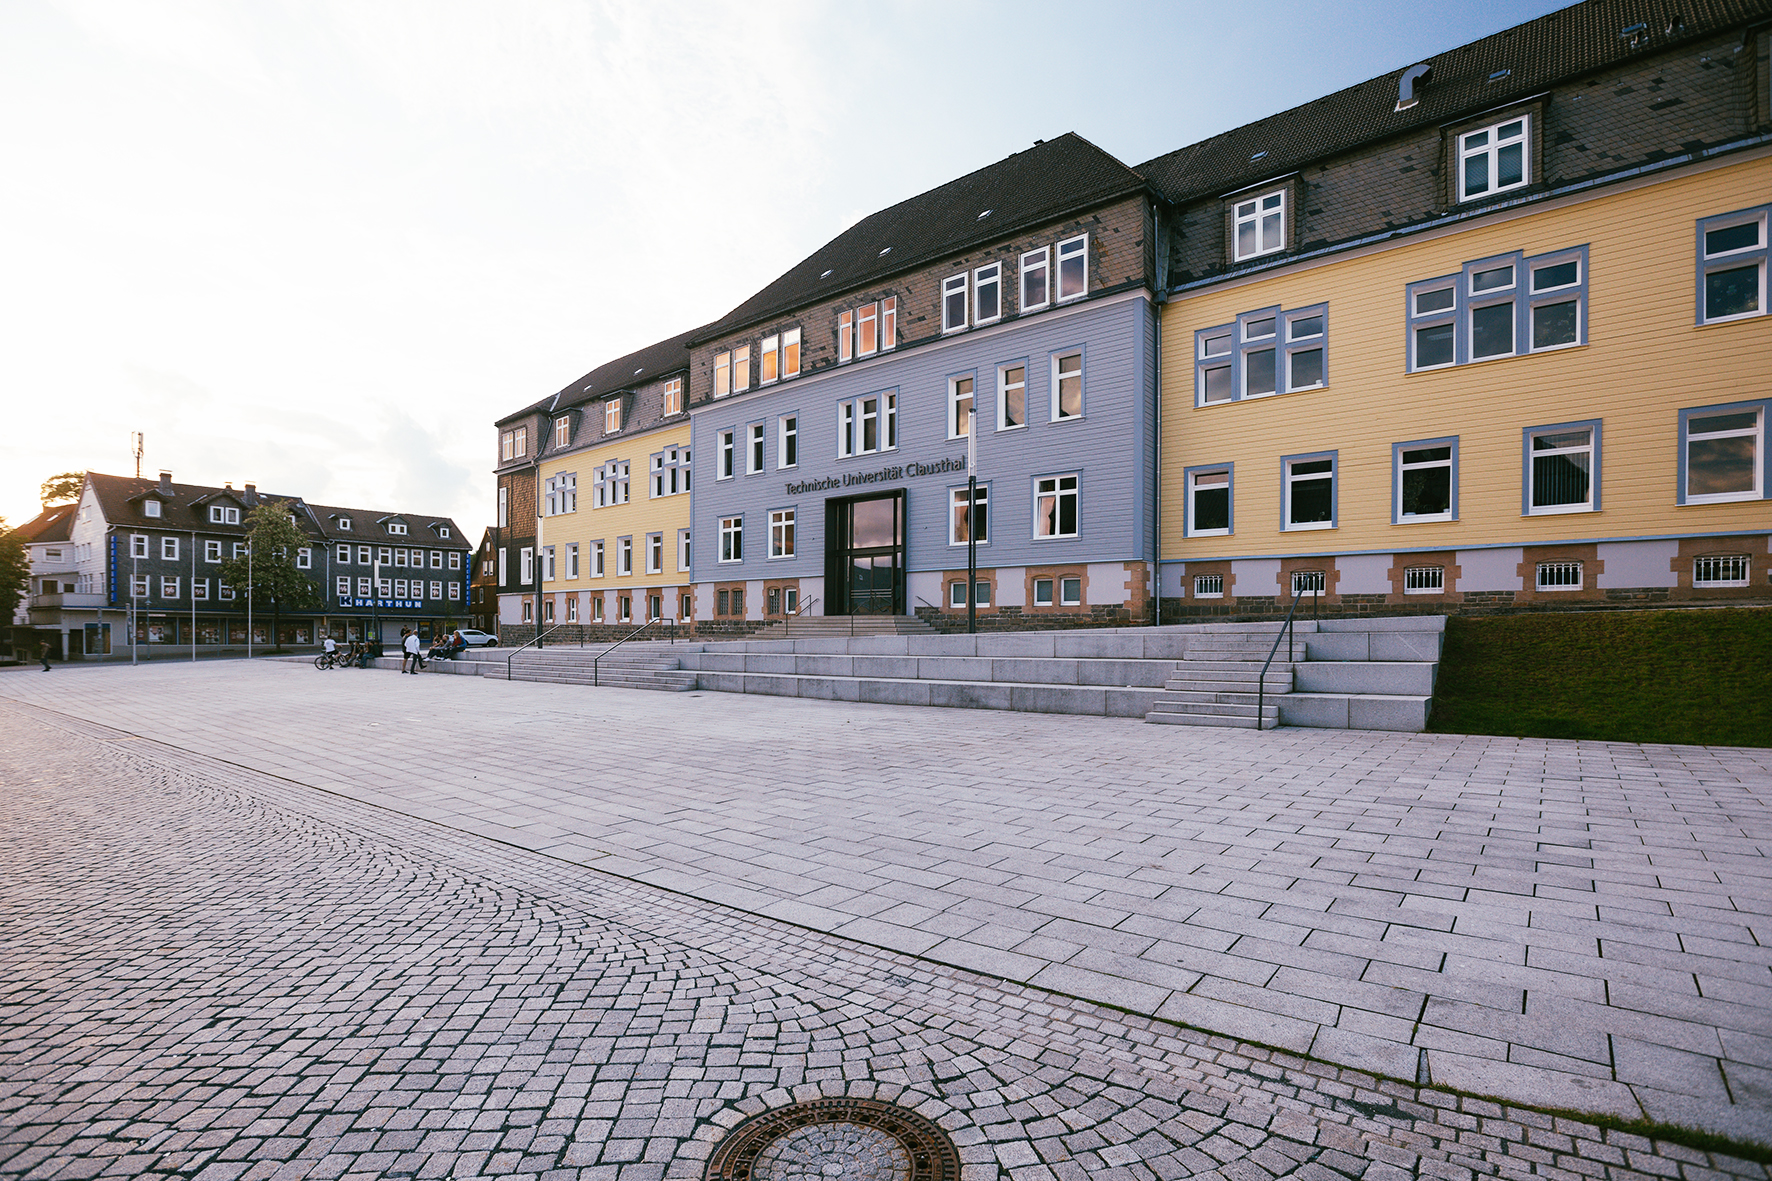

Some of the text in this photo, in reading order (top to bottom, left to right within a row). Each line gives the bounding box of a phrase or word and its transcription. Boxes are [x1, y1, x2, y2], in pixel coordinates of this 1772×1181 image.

[785, 455, 966, 495] Technische Universität Clausthal
[340, 597, 351, 605] K
